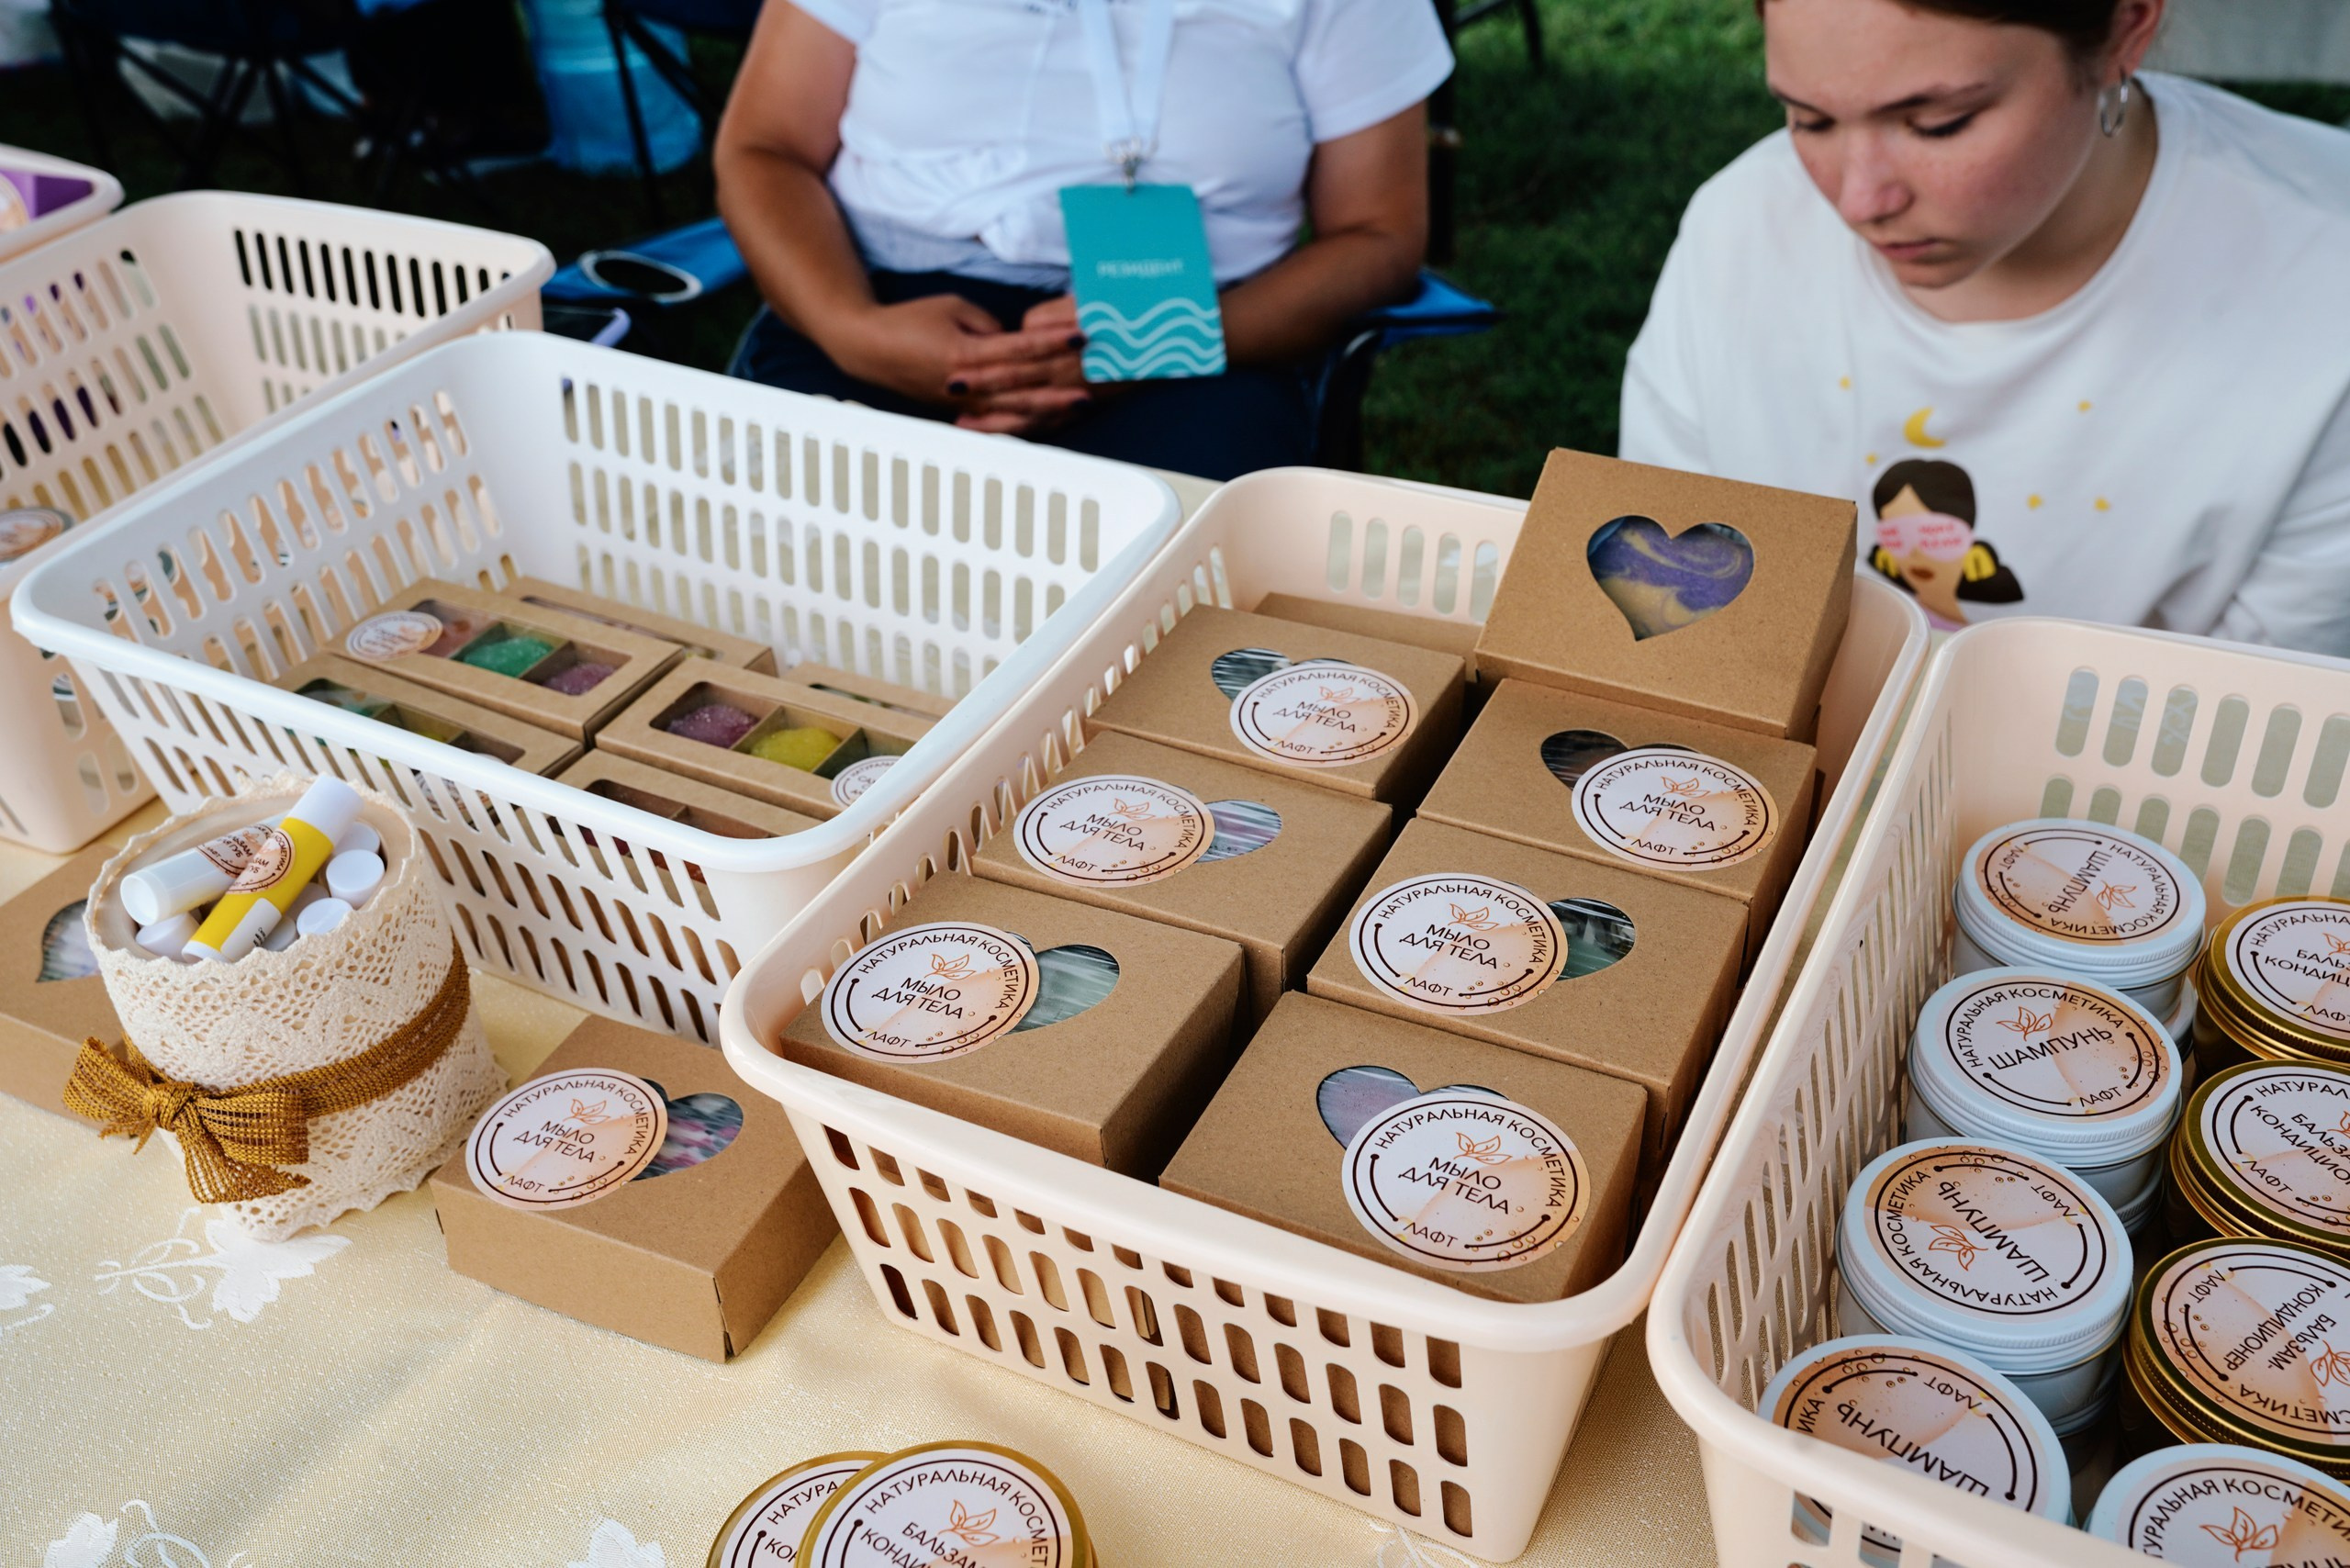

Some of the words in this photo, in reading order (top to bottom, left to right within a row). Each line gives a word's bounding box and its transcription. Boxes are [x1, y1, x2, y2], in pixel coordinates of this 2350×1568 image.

[1257, 671, 1358, 700] НАТУРАЛЬНАЯ
[1358, 677, 1401, 729] КОСМЕТИКА
[1296, 701, 1351, 719] МЫЛО
[1272, 708, 1312, 722] ДЛЯ
[1316, 715, 1356, 733] ТЕЛА
[1275, 740, 1316, 755] ЛАФТ
[1595, 759, 1699, 790] НАТУРАЛЬНАЯ
[1702, 767, 1759, 826] КОСМЕТИКА
[1643, 794, 1705, 815] МЫЛО
[1046, 783, 1158, 810] НАТУРАЛЬНАЯ
[1158, 793, 1195, 849] КОСМЕТИКА
[1086, 813, 1143, 836] МЫЛО
[1619, 801, 1662, 816] ДЛЯ
[1667, 809, 1715, 832] ТЕЛА
[1059, 820, 1101, 836] ДЛЯ
[1103, 830, 1146, 852] ТЕЛА
[1630, 838, 1678, 856] ЛАФТ
[1055, 856, 1098, 872] ЛАФТ
[1998, 846, 2024, 870] ЛАФТ
[2048, 850, 2112, 913] ШАМПУНЬ
[2109, 844, 2170, 915] НАТУРАЛЬНАЯ
[1378, 884, 1493, 920] НАТУРАЛЬНАЯ
[1494, 893, 1548, 964] КОСМЕТИКА
[1426, 924, 1491, 950] МЫЛО
[2051, 915, 2157, 935] КОСМЕТИКА
[2250, 914, 2350, 947] НАТУРАЛЬНА
[1398, 933, 1445, 952] ДЛЯ
[1449, 945, 1497, 969] ТЕЛА
[2297, 948, 2350, 971] БАЛЬ
[858, 933, 979, 974] НАТУРАЛЬНАЯ
[978, 939, 1019, 1010] КОСМЕТИКА
[1404, 977, 1454, 997] ЛАФТ
[2265, 956, 2350, 987] КОНДИЦ
[871, 987, 916, 1006] ДЛЯ
[917, 997, 964, 1019] ТЕЛА
[901, 977, 961, 1001] МЫЛО
[865, 1031, 912, 1047] ЛАФТ
[1956, 991, 2008, 1068] НАТУРАЛЬНАЯ
[2008, 988, 2124, 1029] КОСМЕТИКА
[1987, 1026, 2113, 1070] ШАМПУНЬ
[2079, 1086, 2122, 1107] ЛАФТ
[2255, 1081, 2350, 1100] НАТУРАЛ
[503, 1080, 617, 1118] НАТУРАЛЬНАЯ
[614, 1087, 649, 1156] КОСМЕТИКА
[540, 1121, 595, 1145] МЫЛО
[513, 1130, 554, 1148] ДЛЯ
[554, 1139, 595, 1163] ТЕЛА
[1374, 1108, 1505, 1149] НАТУРАЛЬНАЯ
[1506, 1120, 1567, 1207] КОСМЕТИКА
[2250, 1105, 2350, 1185] КОНДИЦИО
[503, 1175, 545, 1193] ЛАФТ
[1428, 1157, 1502, 1191] МЫЛО
[2242, 1160, 2293, 1193] ЛАФТ
[1398, 1167, 1450, 1191] ДЛЯ
[1454, 1182, 1509, 1215] ТЕЛА
[2031, 1184, 2077, 1217] ЛАФТ
[1886, 1170, 1931, 1257] КОСМЕТИКА
[1403, 1222, 1459, 1249] ЛАФТ
[1938, 1181, 2051, 1283] ШАМПУНЬ
[1909, 1257, 2059, 1306] НАТУРАЛЬНАЯ
[2188, 1270, 2226, 1304] ЛАФТ
[2223, 1283, 2325, 1371] КОНДИЦИОНЕР
[1923, 1376, 1983, 1410] ЛАФТ
[2240, 1383, 2350, 1425] СМЕТИКА
[1836, 1402, 1990, 1497] ШАМПУНЬ
[767, 1480, 839, 1525] НАТУРА
[865, 1469, 1011, 1515] НАТУРАЛЬНАЯ
[1009, 1490, 1050, 1566] КОСМЕТ
[2222, 1478, 2350, 1540] КОСМЕТИ
